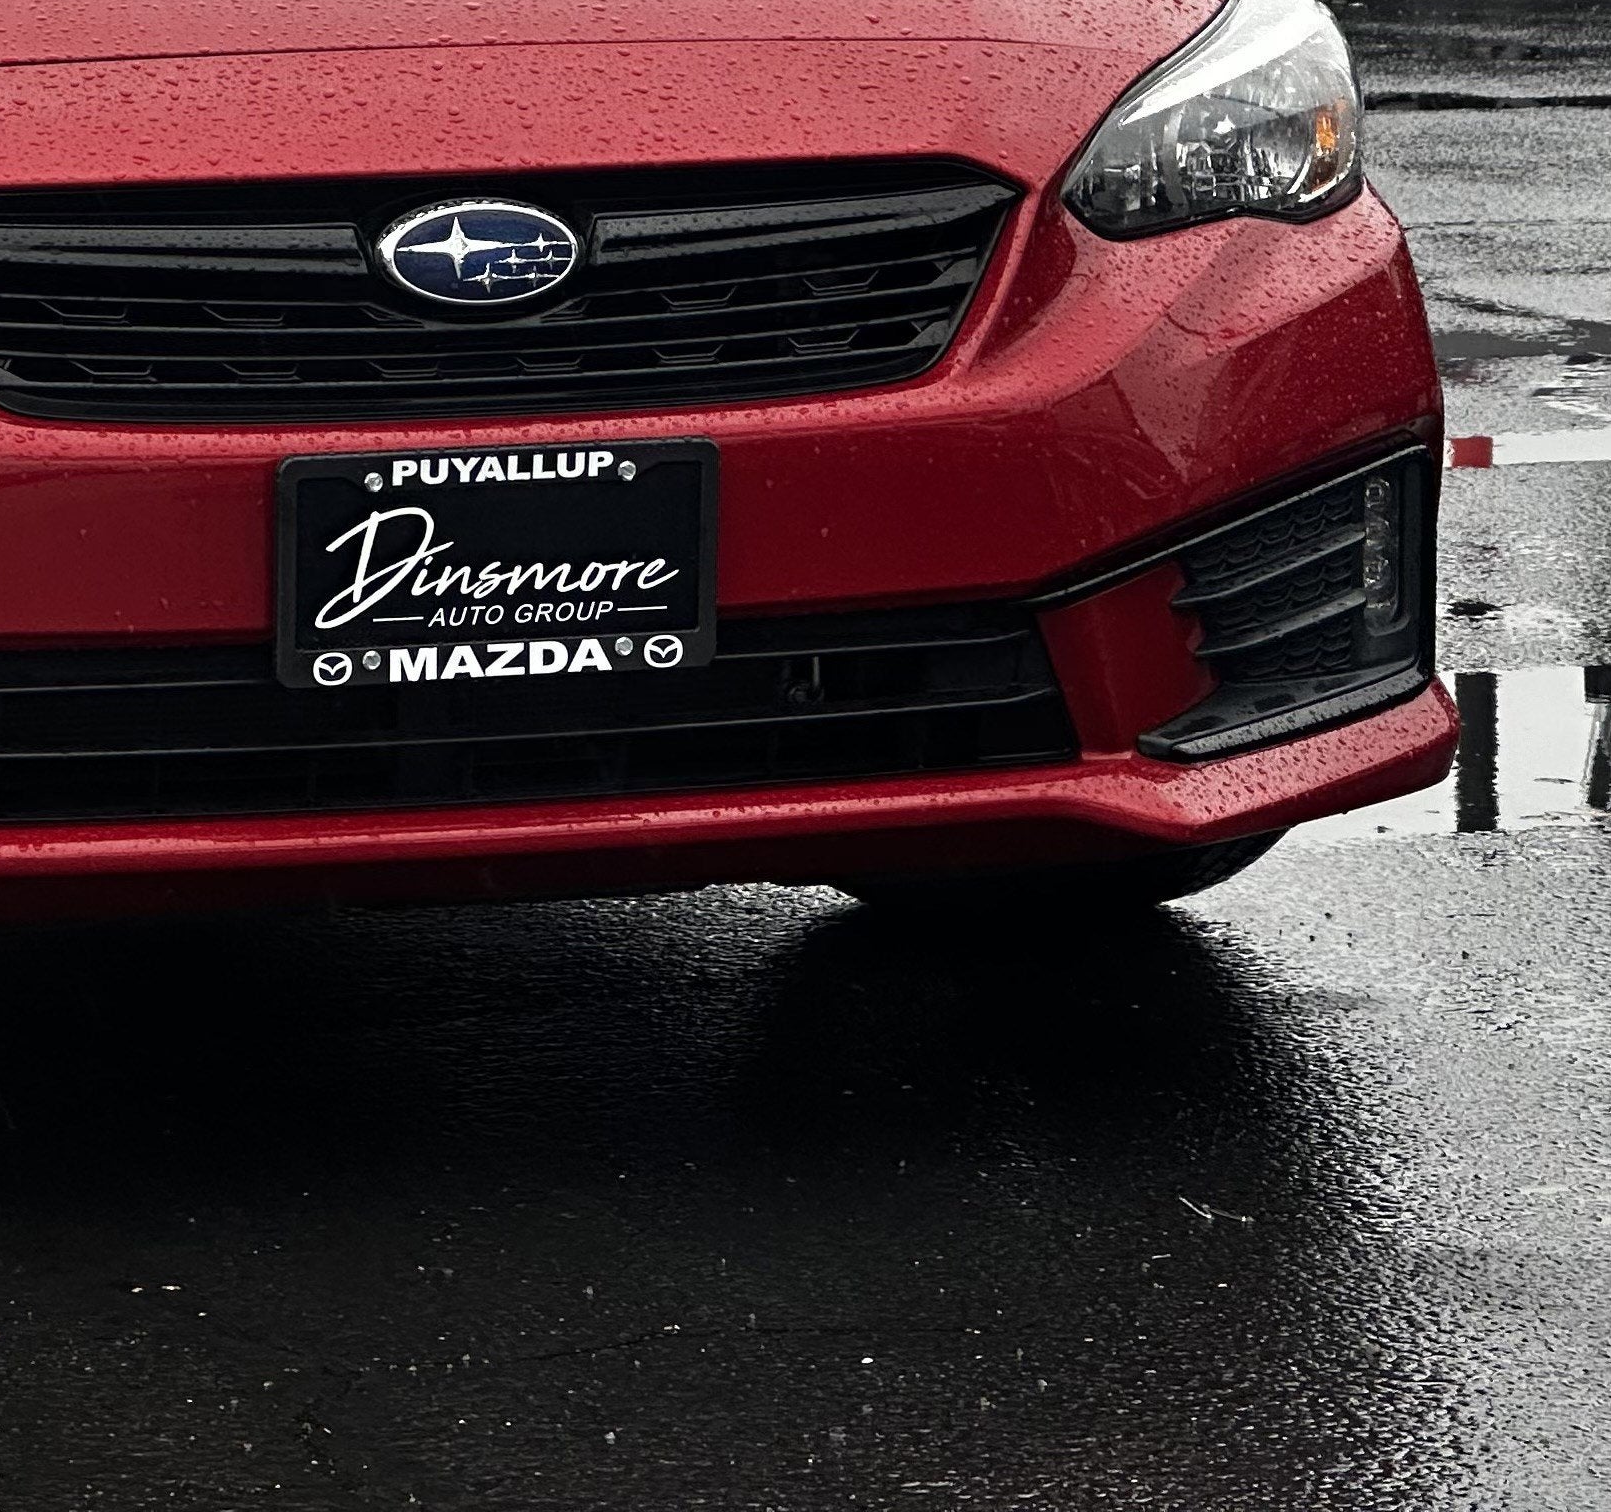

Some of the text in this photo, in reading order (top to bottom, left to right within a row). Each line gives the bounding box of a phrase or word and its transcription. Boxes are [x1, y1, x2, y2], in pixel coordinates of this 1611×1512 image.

[391, 450, 615, 487] PUYALLUP
[314, 506, 680, 630] Dinsmore
[427, 600, 615, 628] AUTO GROUP
[389, 638, 614, 683] MAZDA
